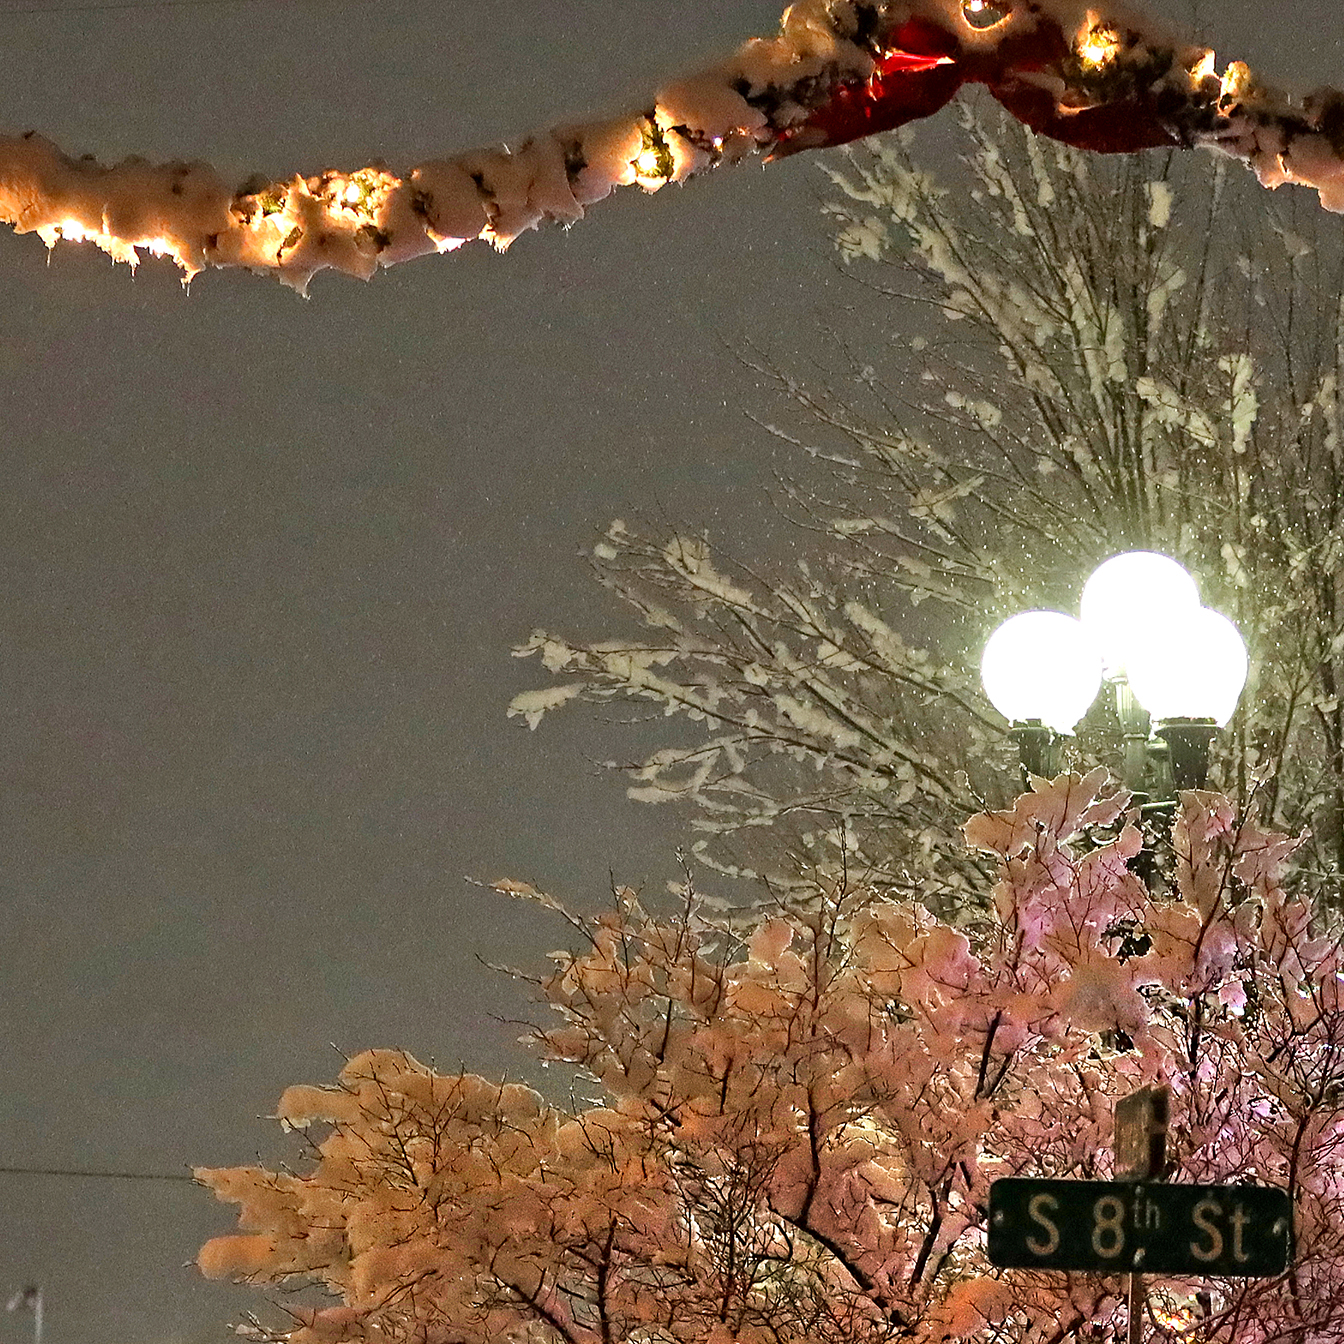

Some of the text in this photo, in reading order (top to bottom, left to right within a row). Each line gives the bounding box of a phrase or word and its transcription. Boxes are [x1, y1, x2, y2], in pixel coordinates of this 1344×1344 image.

[1026, 1194, 1251, 1262] S 8th St
